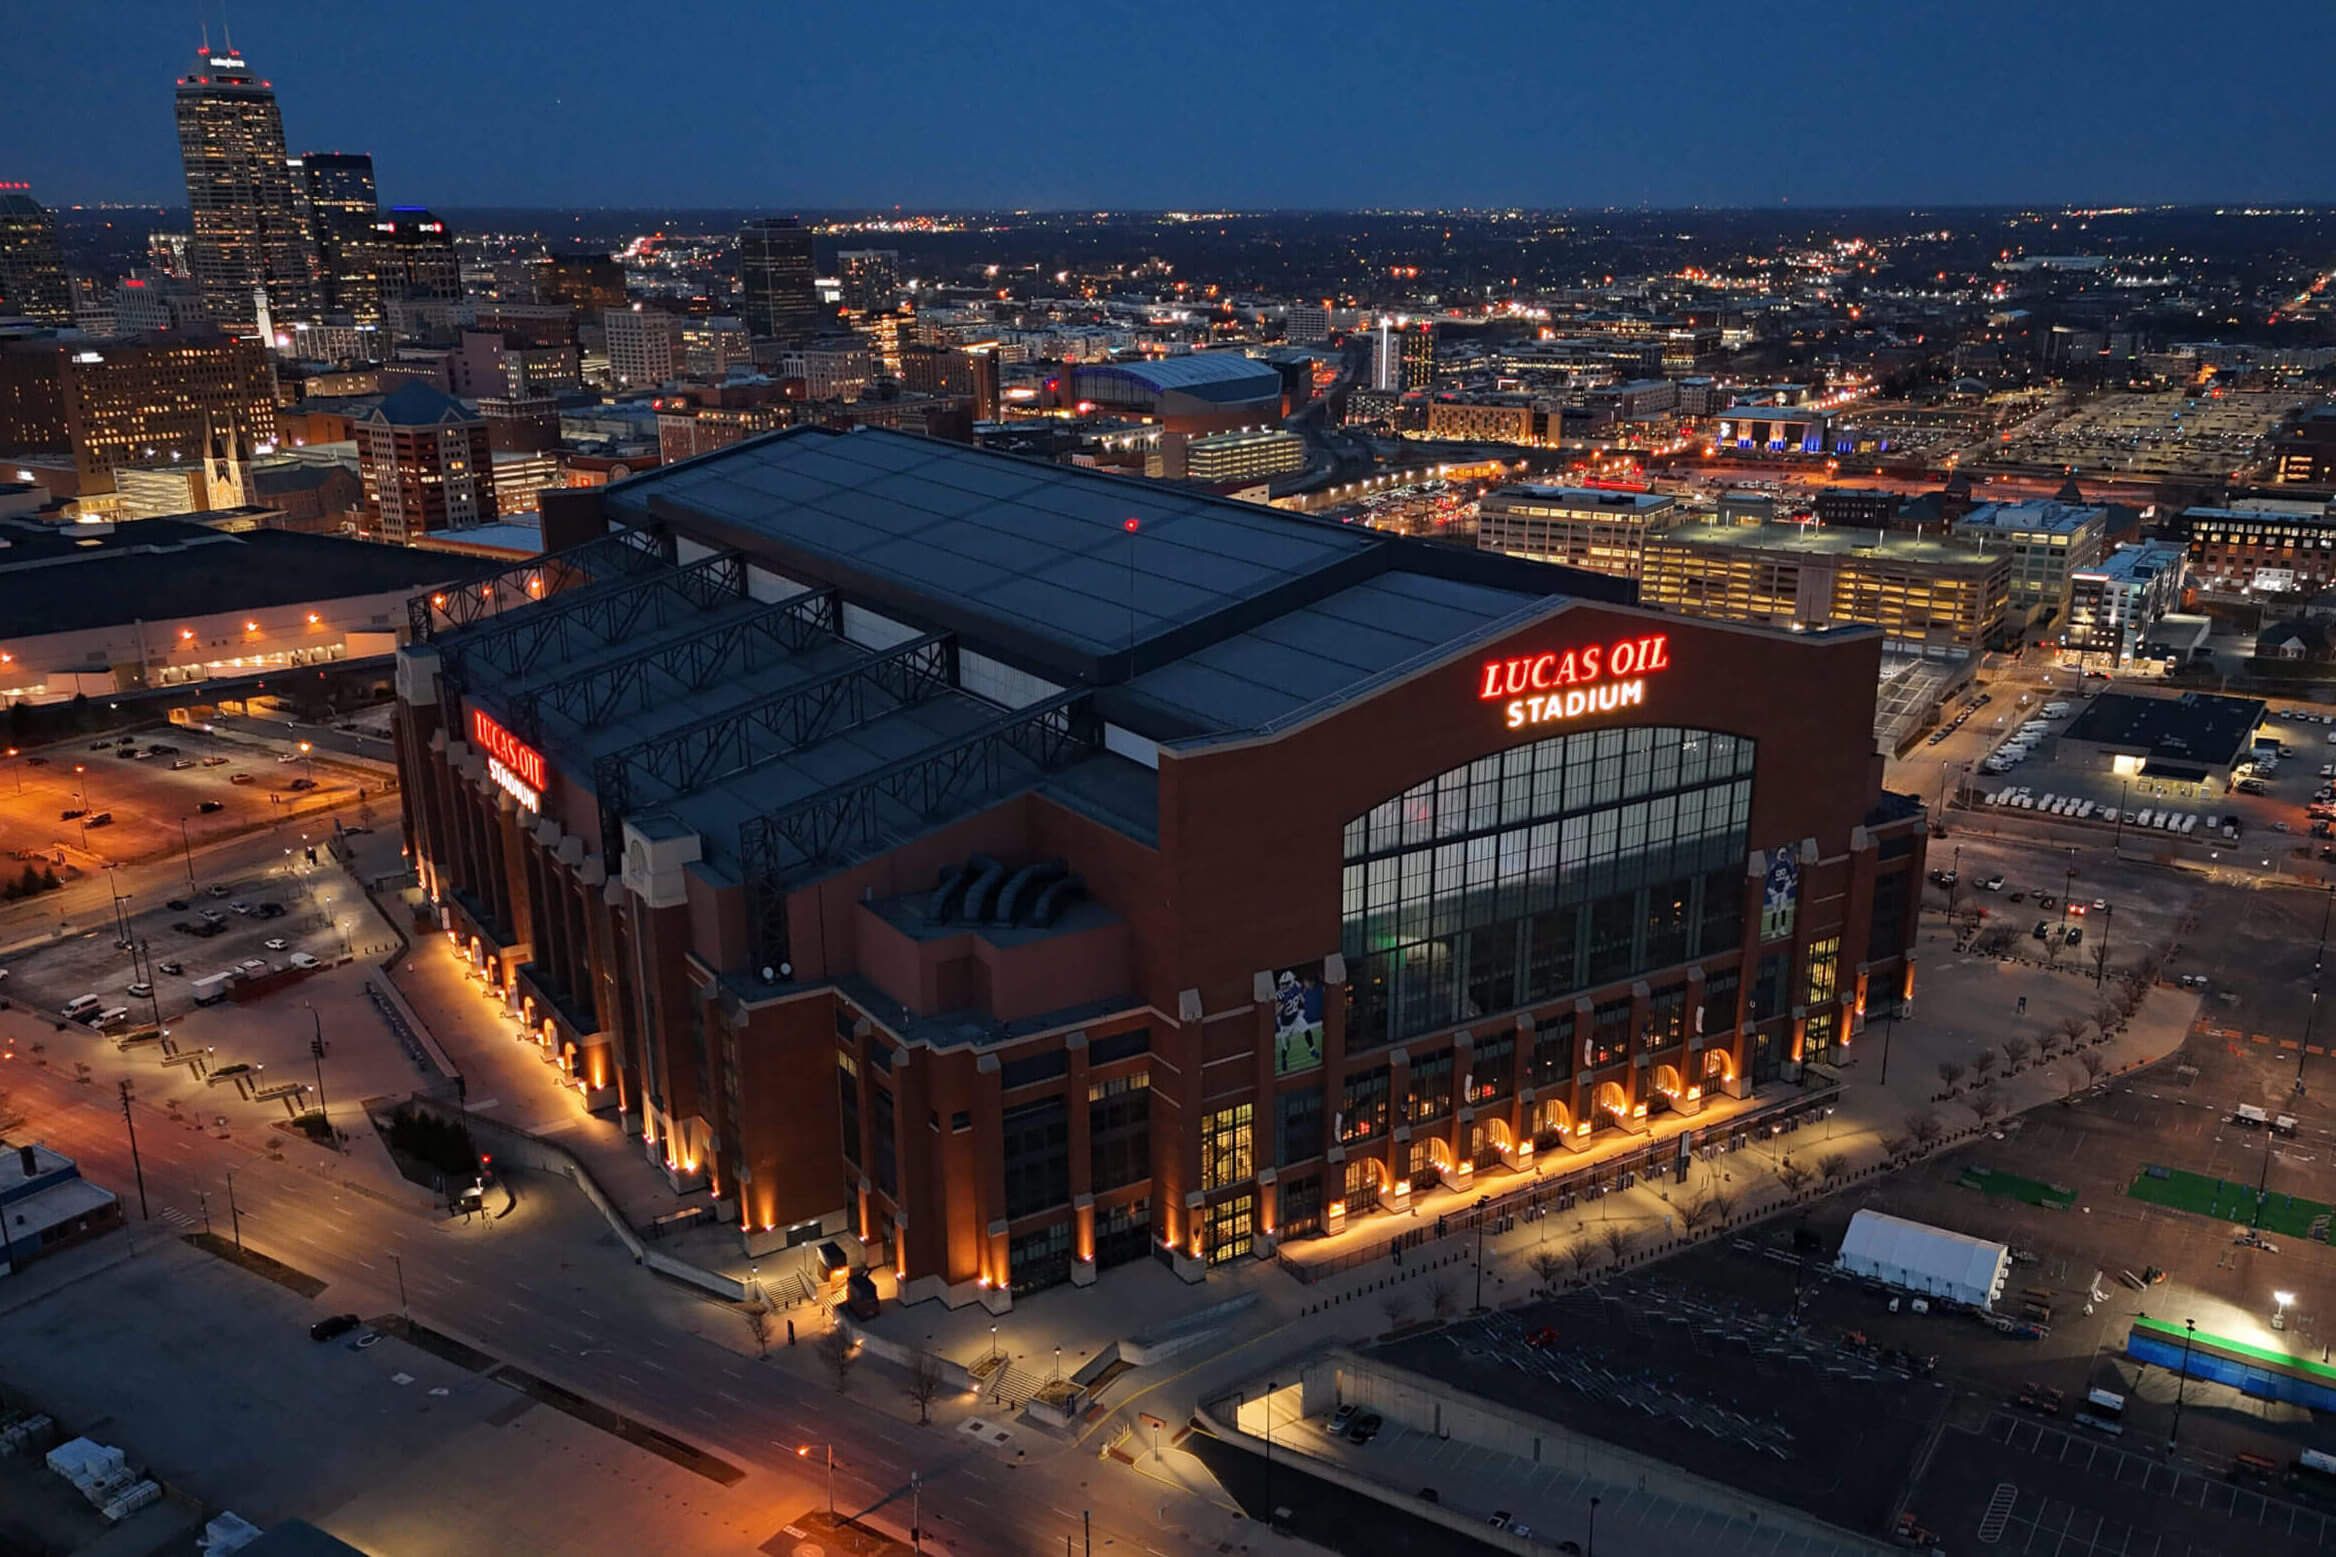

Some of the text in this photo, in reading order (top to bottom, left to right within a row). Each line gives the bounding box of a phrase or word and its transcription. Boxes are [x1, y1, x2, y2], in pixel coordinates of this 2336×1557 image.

[1482, 637, 1668, 698] LUCAS OIL
[1508, 680, 1643, 727] STADIUM
[475, 711, 545, 790] LUCAS OIL
[488, 756, 537, 814] STADIUM
[1286, 997, 1299, 1015] 28
